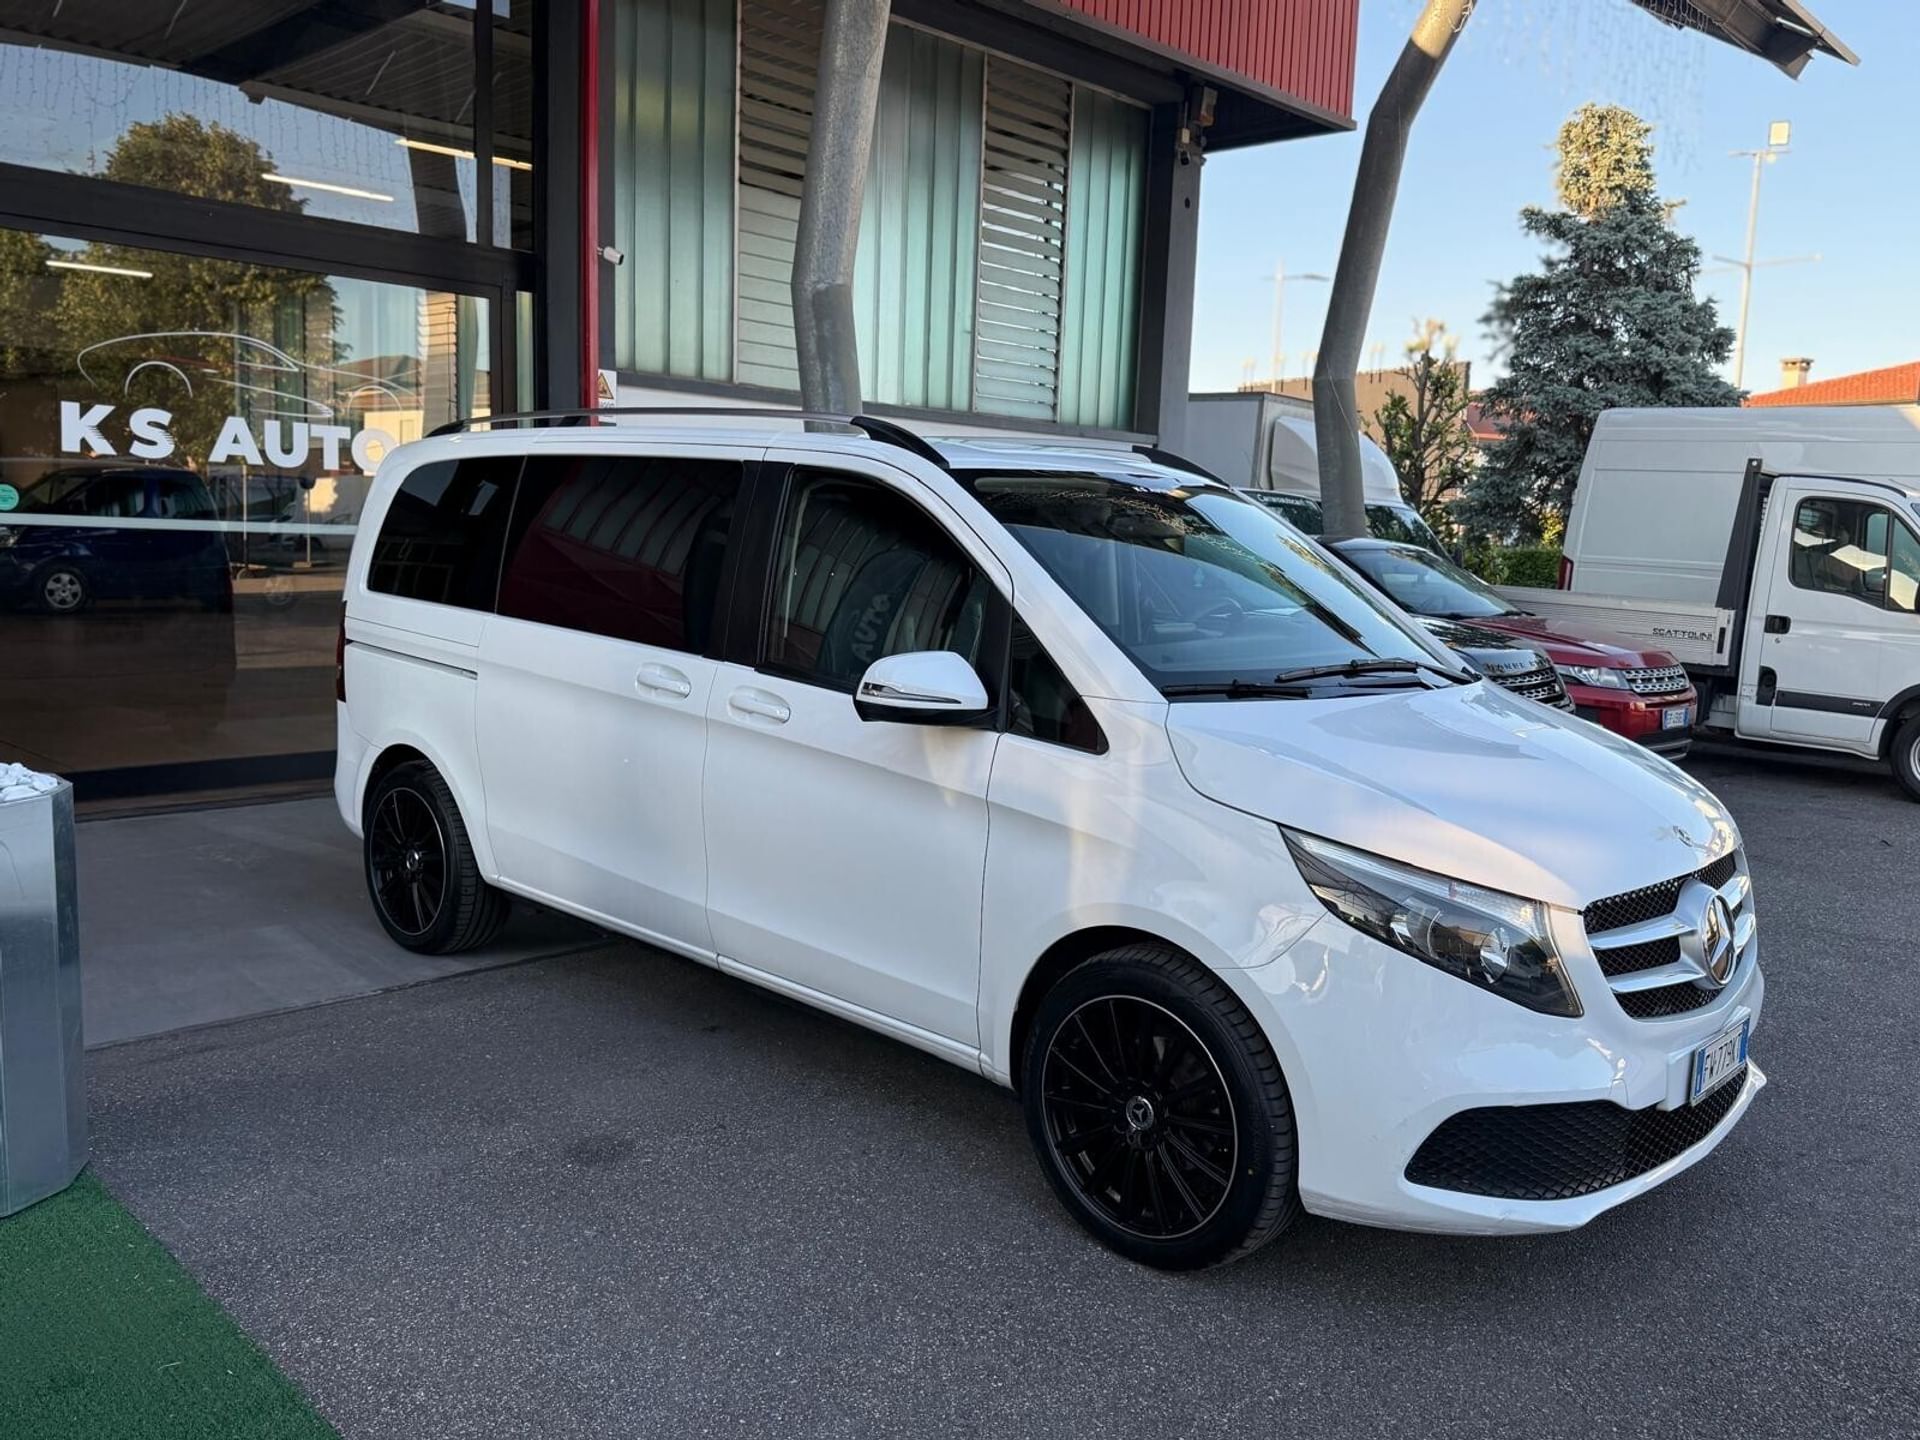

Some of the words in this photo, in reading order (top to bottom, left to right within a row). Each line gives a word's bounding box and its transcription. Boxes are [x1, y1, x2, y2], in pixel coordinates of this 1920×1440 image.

[60, 400, 176, 459] KS
[208, 416, 398, 476] AUTO
[1652, 627, 1713, 641] SCATTOLINI
